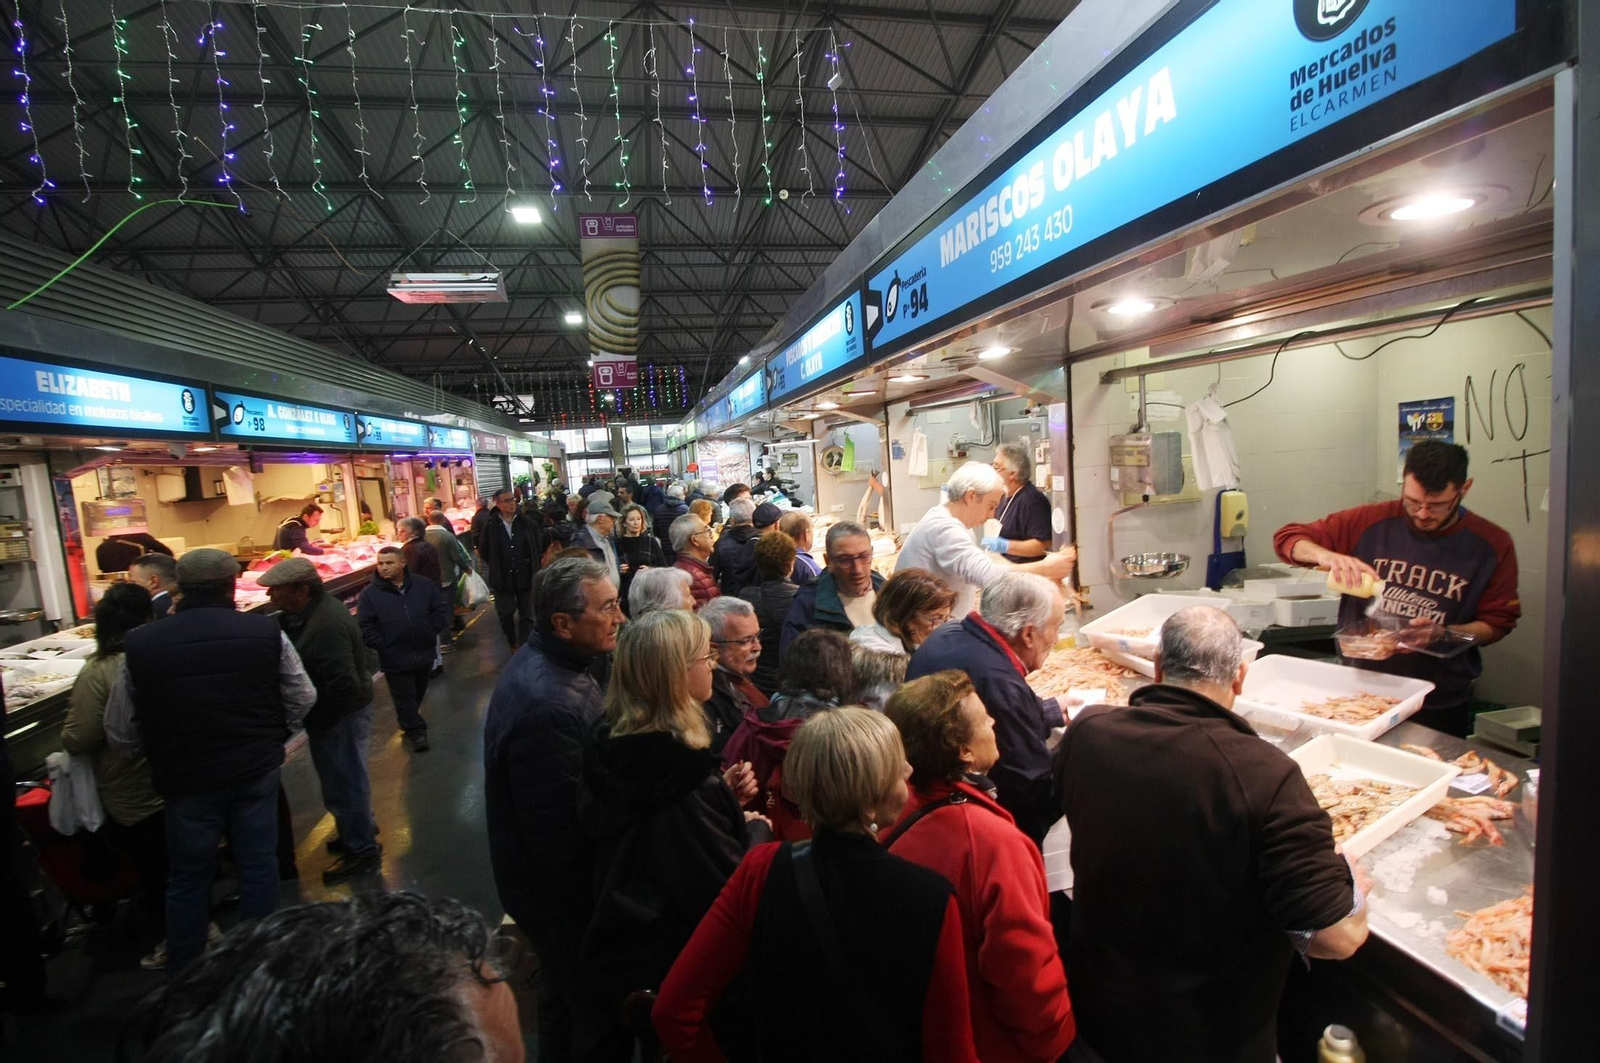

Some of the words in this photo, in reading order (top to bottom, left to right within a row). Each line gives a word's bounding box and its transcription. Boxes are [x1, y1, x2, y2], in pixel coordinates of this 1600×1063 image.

[1289, 16, 1397, 91] Mercados
[1290, 87, 1314, 112] de
[1318, 42, 1397, 98] Huelva
[939, 160, 1045, 268] MARISCOS
[1052, 65, 1177, 192] OLAYA
[990, 241, 1012, 273] 959
[1015, 227, 1040, 260] 243
[1044, 204, 1073, 242] 430
[0, 398, 67, 415] specialidad
[68, 404, 83, 416] en
[35, 370, 132, 403] ELIZABETH
[1373, 558, 1470, 603] TRACK
